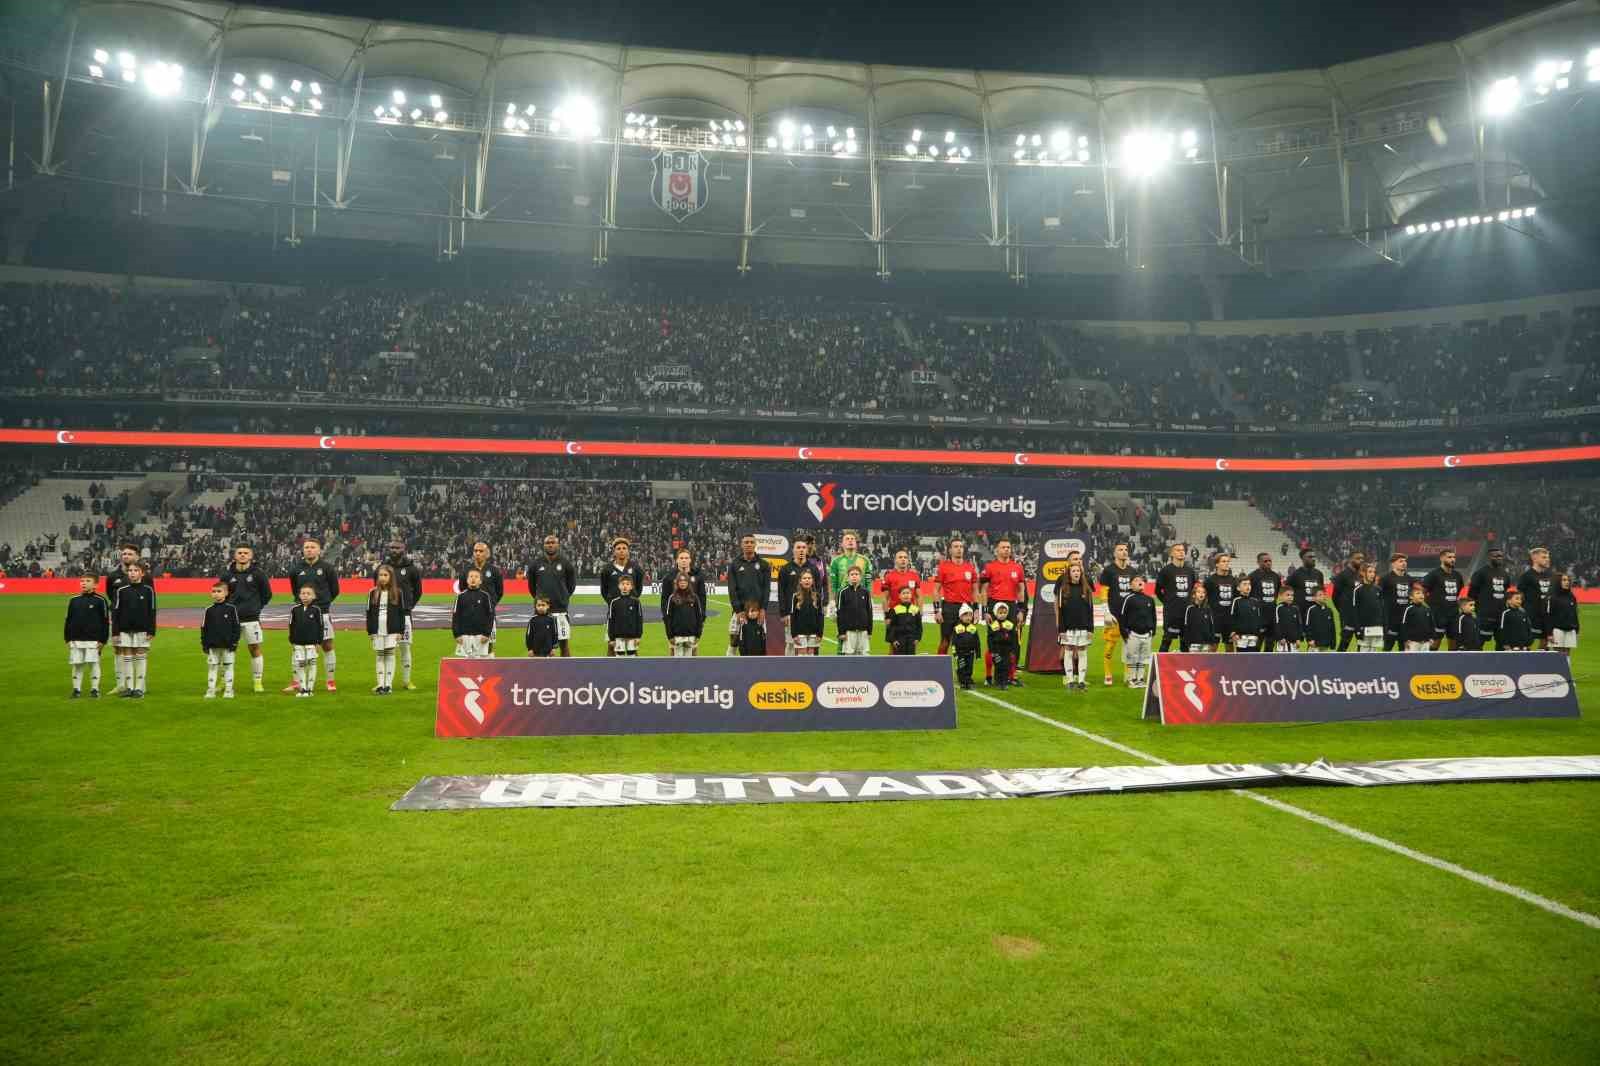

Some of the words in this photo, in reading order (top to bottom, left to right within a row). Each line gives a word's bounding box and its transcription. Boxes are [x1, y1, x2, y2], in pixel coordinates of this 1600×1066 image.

[841, 490, 949, 516] trendyol
[952, 496, 1036, 519] SüperLig
[511, 681, 634, 710] trendyol
[638, 684, 734, 710] SüperLig
[826, 683, 869, 696] trendyol
[1219, 674, 1319, 700] trendyol
[1321, 677, 1400, 700] SüperLig
